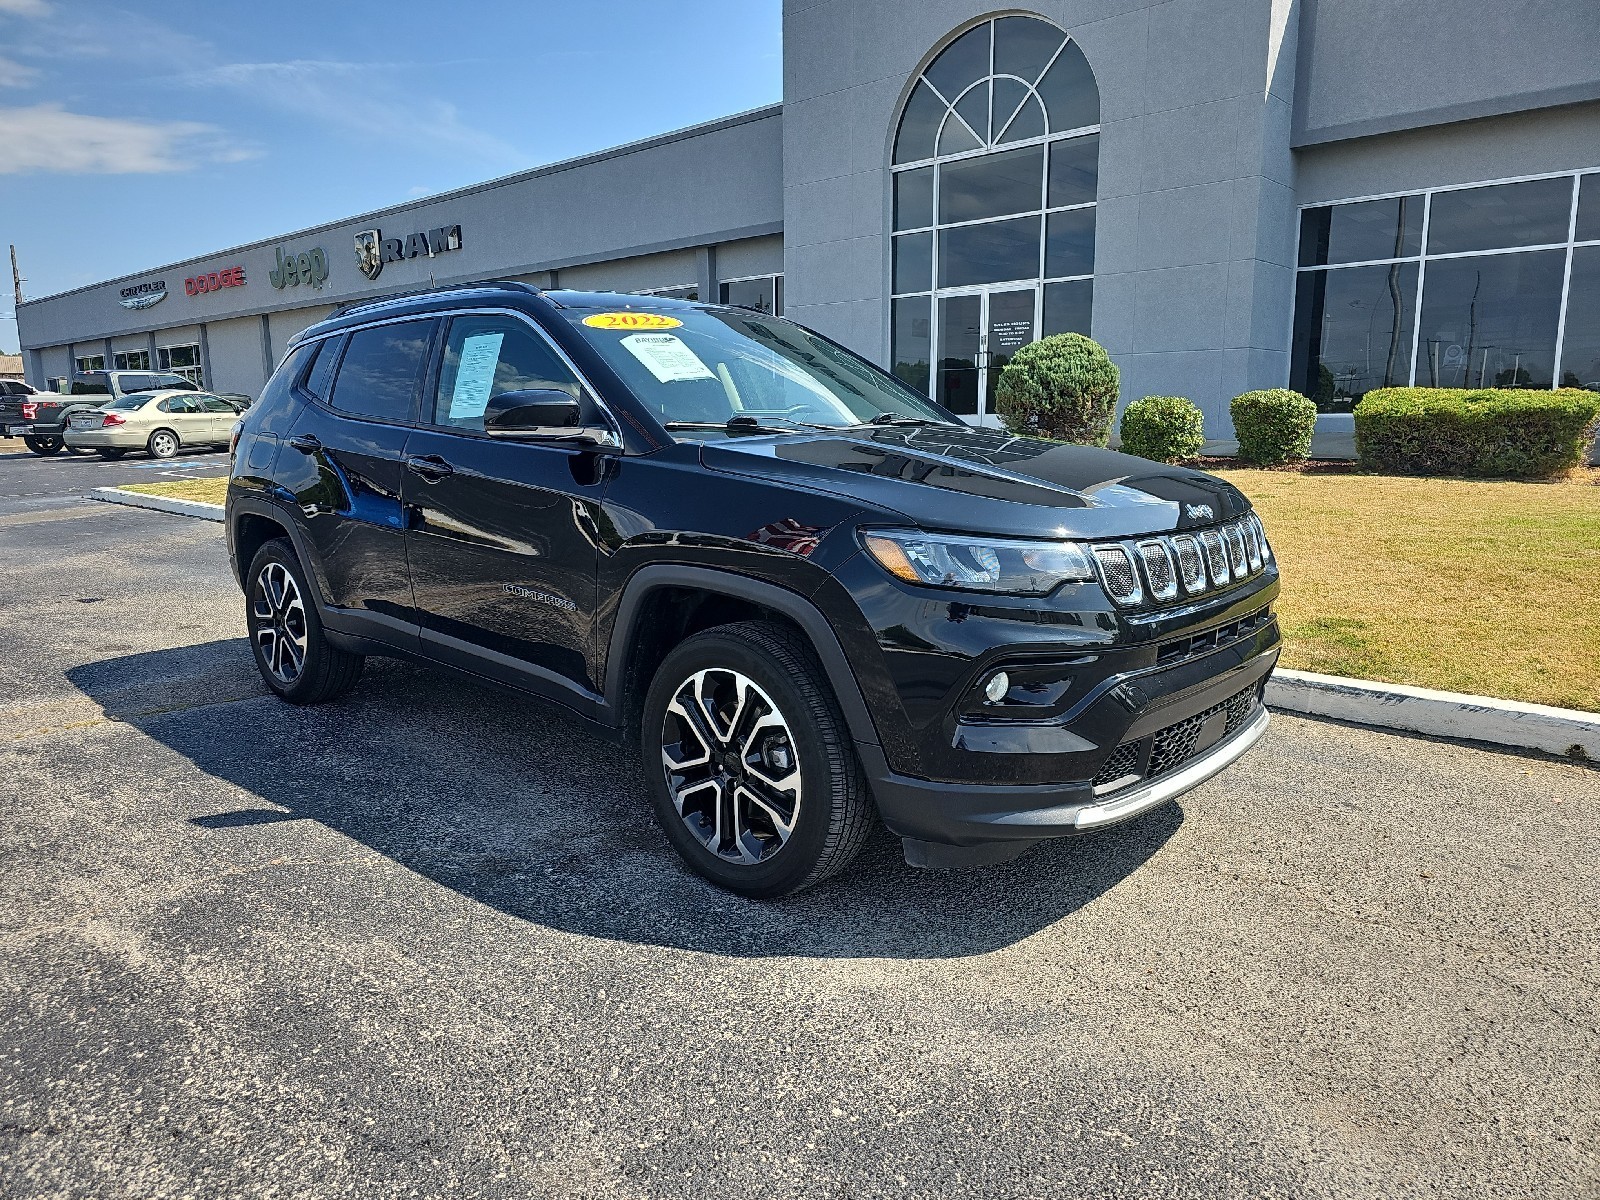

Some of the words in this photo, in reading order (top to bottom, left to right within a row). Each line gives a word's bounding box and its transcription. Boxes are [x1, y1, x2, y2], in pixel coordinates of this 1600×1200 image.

[381, 224, 462, 263] RAM
[185, 266, 247, 296] DODGE
[269, 247, 329, 290] Jeep
[120, 280, 166, 297] CHRYSLER
[604, 315, 670, 326] 2022
[1185, 503, 1214, 521] Jeep
[502, 583, 578, 612] COMPASS
